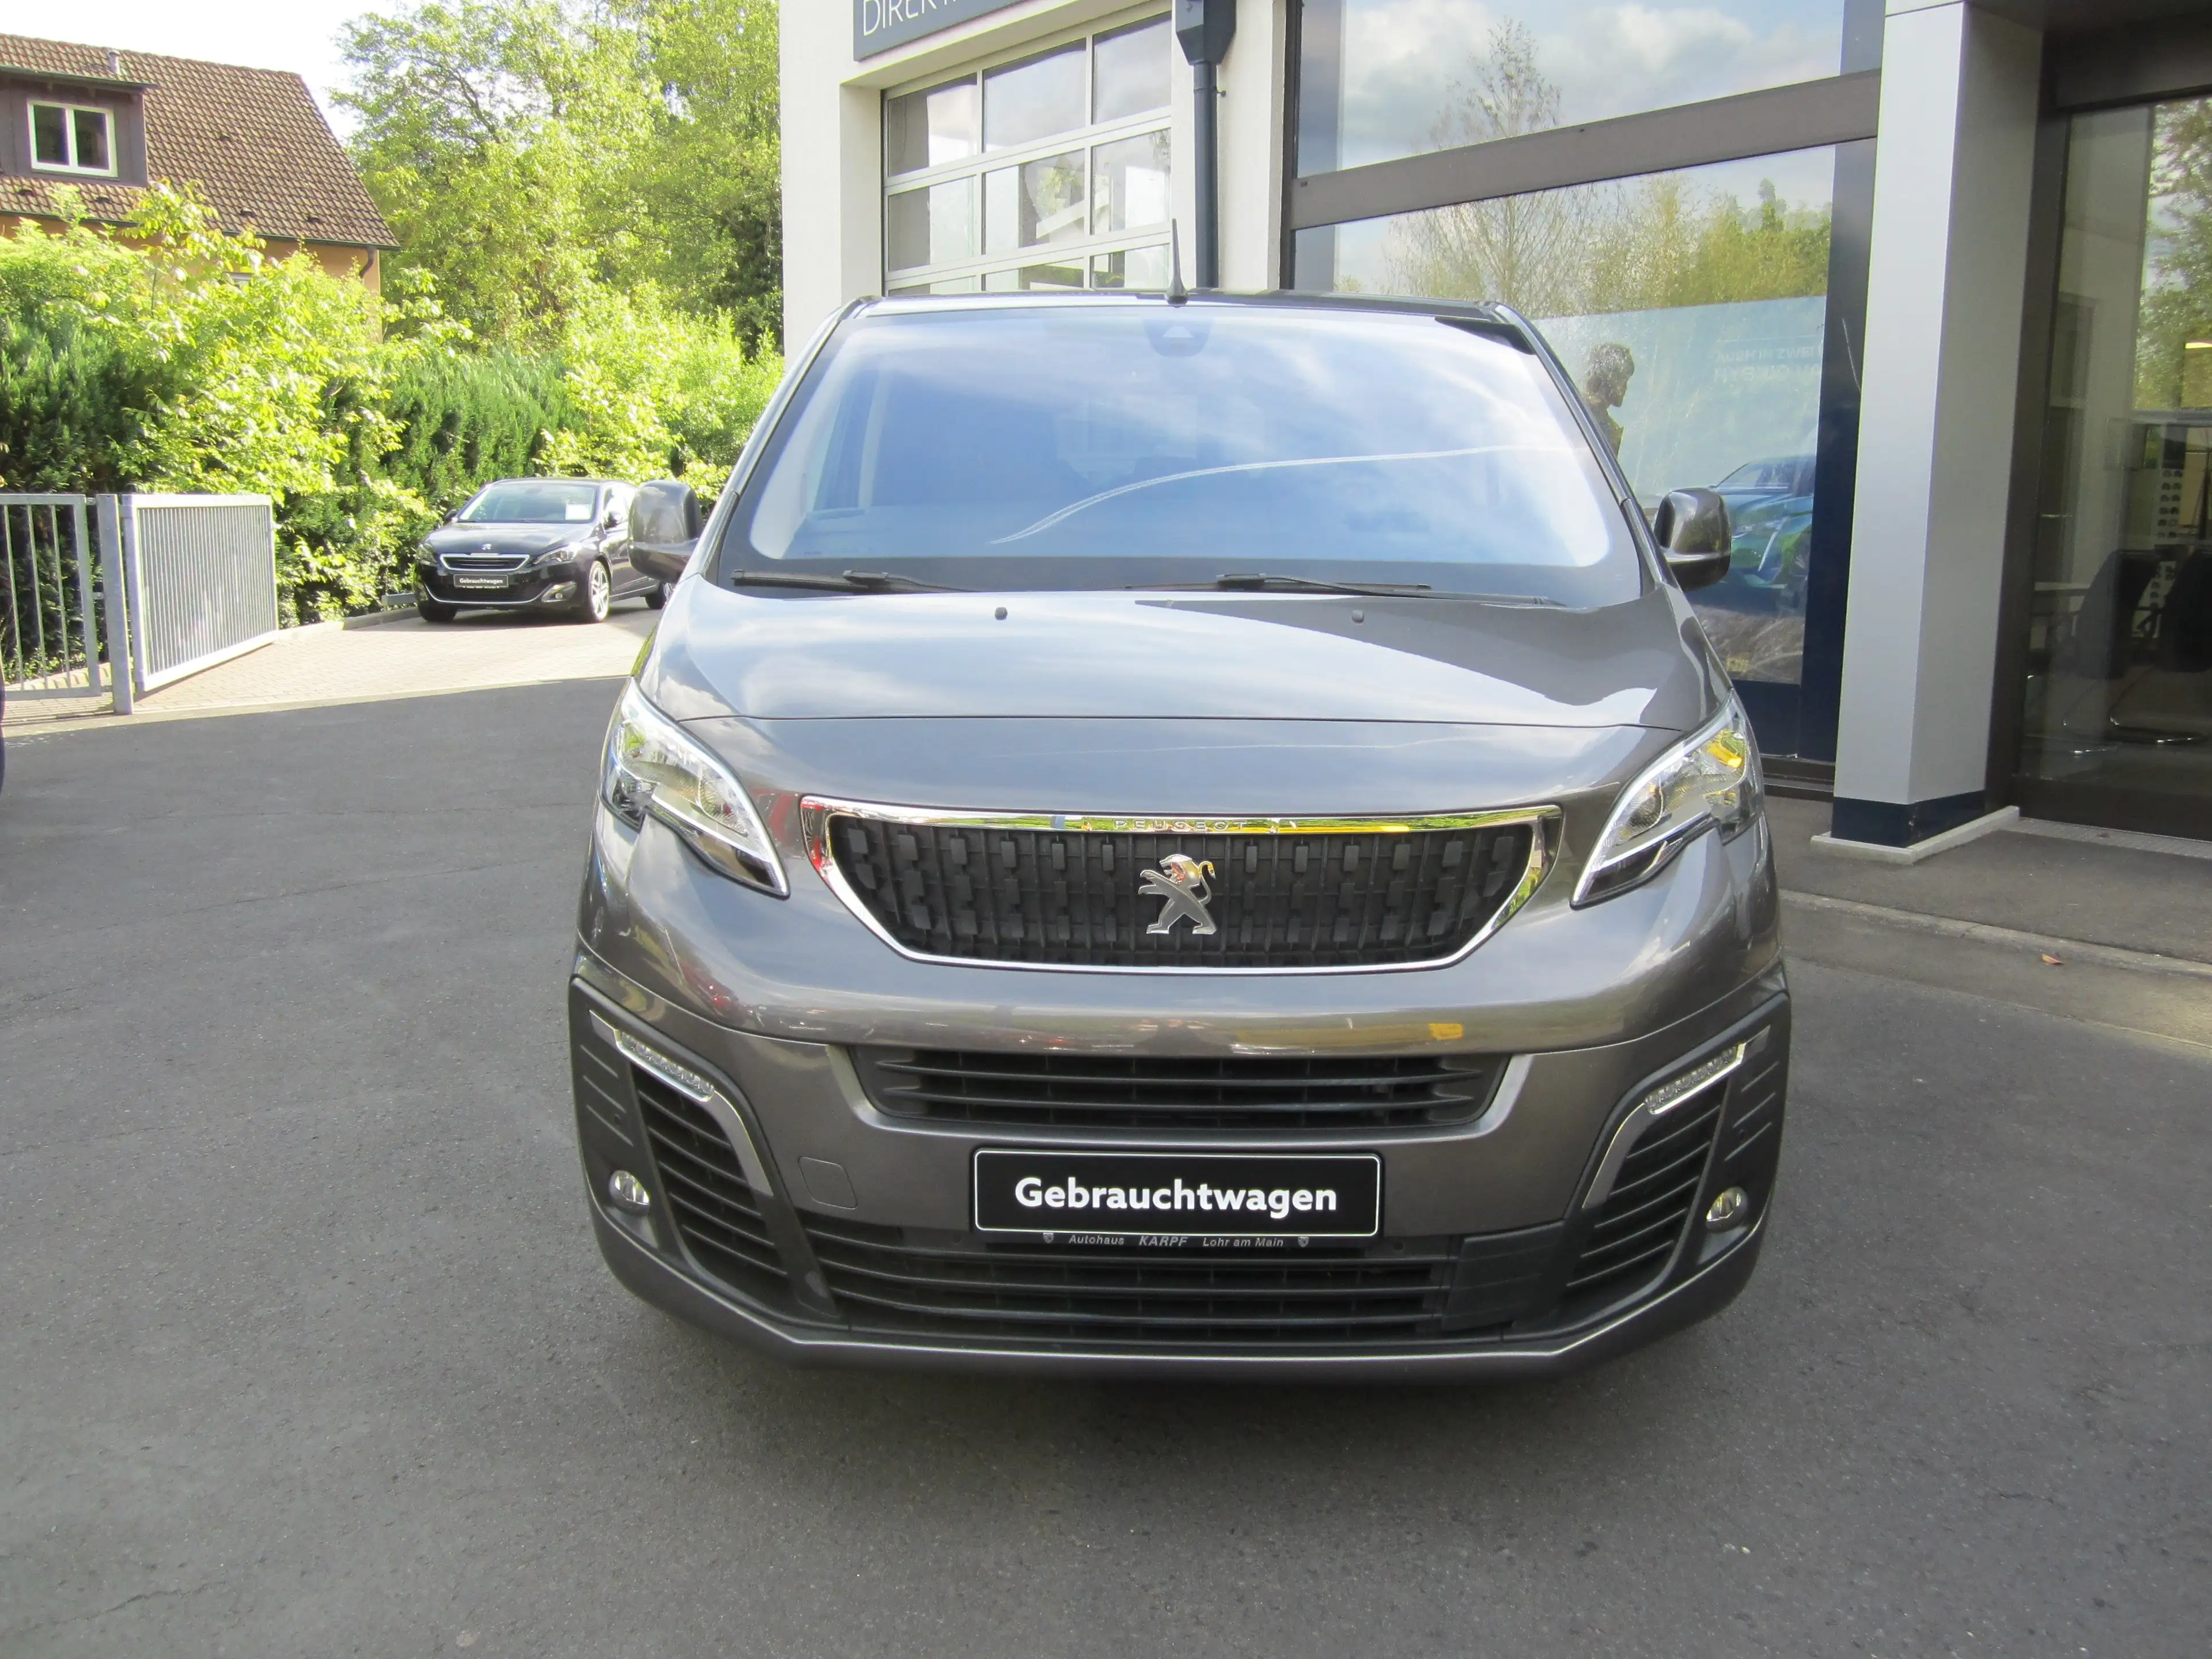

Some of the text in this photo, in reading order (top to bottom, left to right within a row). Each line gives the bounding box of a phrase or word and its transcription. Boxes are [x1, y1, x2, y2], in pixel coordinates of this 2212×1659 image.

[1113, 819, 1248, 832] PEUGEOT
[1015, 1177, 1337, 1219] Gebrauchtwagen
[1069, 1234, 1283, 1247] Autohaus KARPF Lohr am Main
